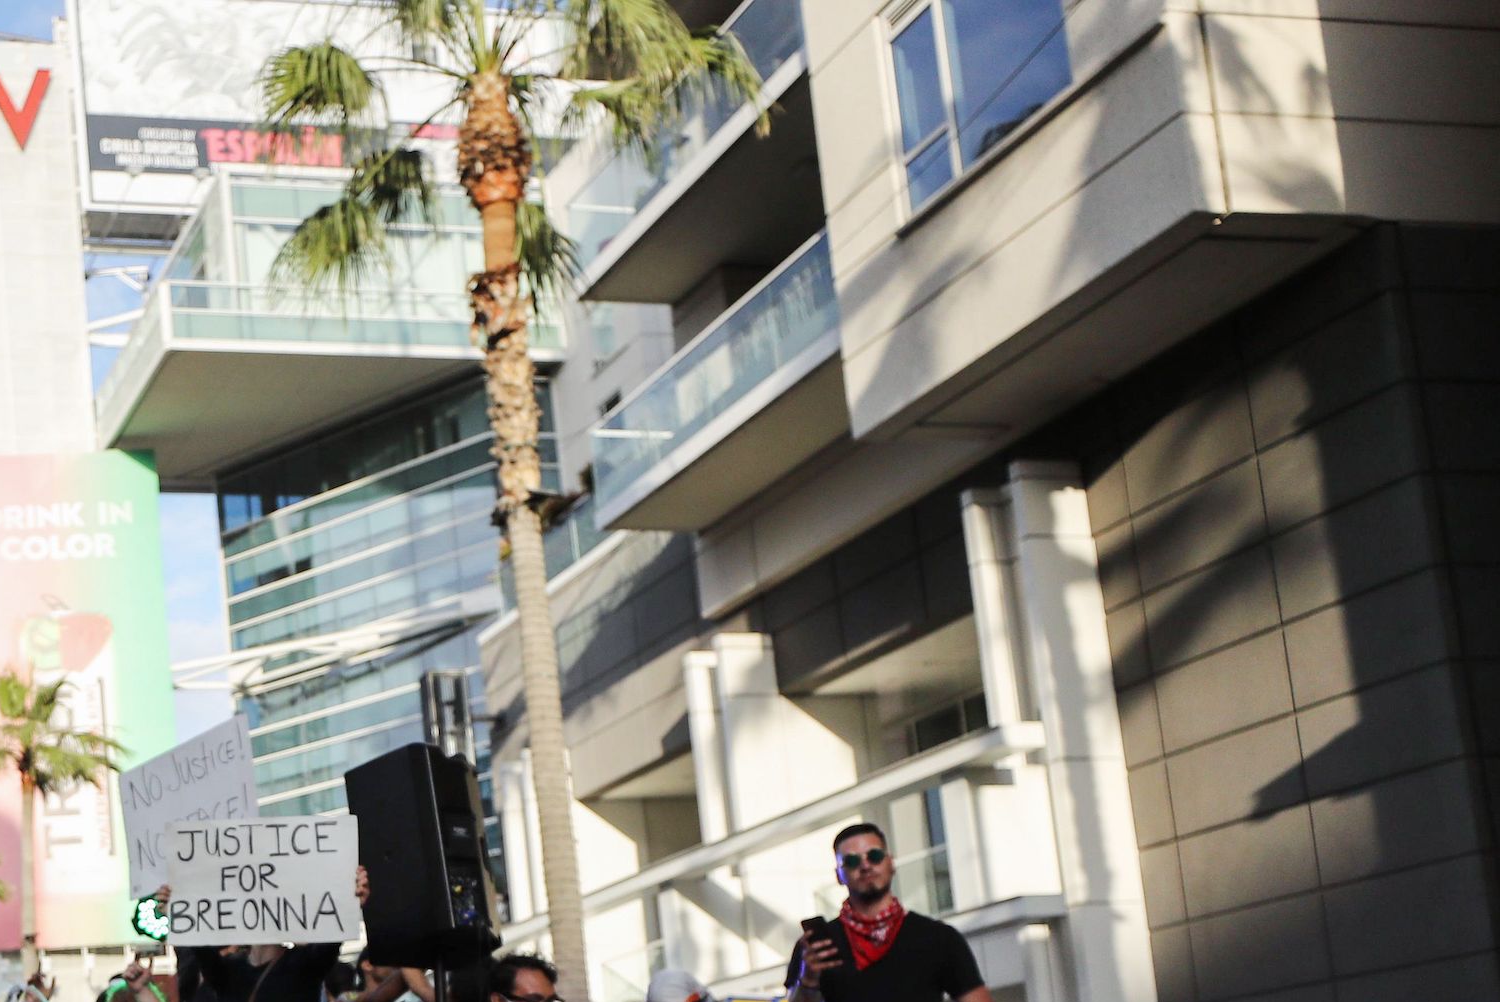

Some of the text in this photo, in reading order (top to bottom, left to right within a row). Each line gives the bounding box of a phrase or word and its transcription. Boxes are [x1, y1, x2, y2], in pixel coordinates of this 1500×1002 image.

[97, 498, 134, 527] IN
[0, 532, 117, 561] COLOR
[128, 770, 164, 811] NO
[176, 820, 339, 863] JUSTICE
[220, 862, 280, 893] FOR
[169, 890, 345, 935] BREONNA
